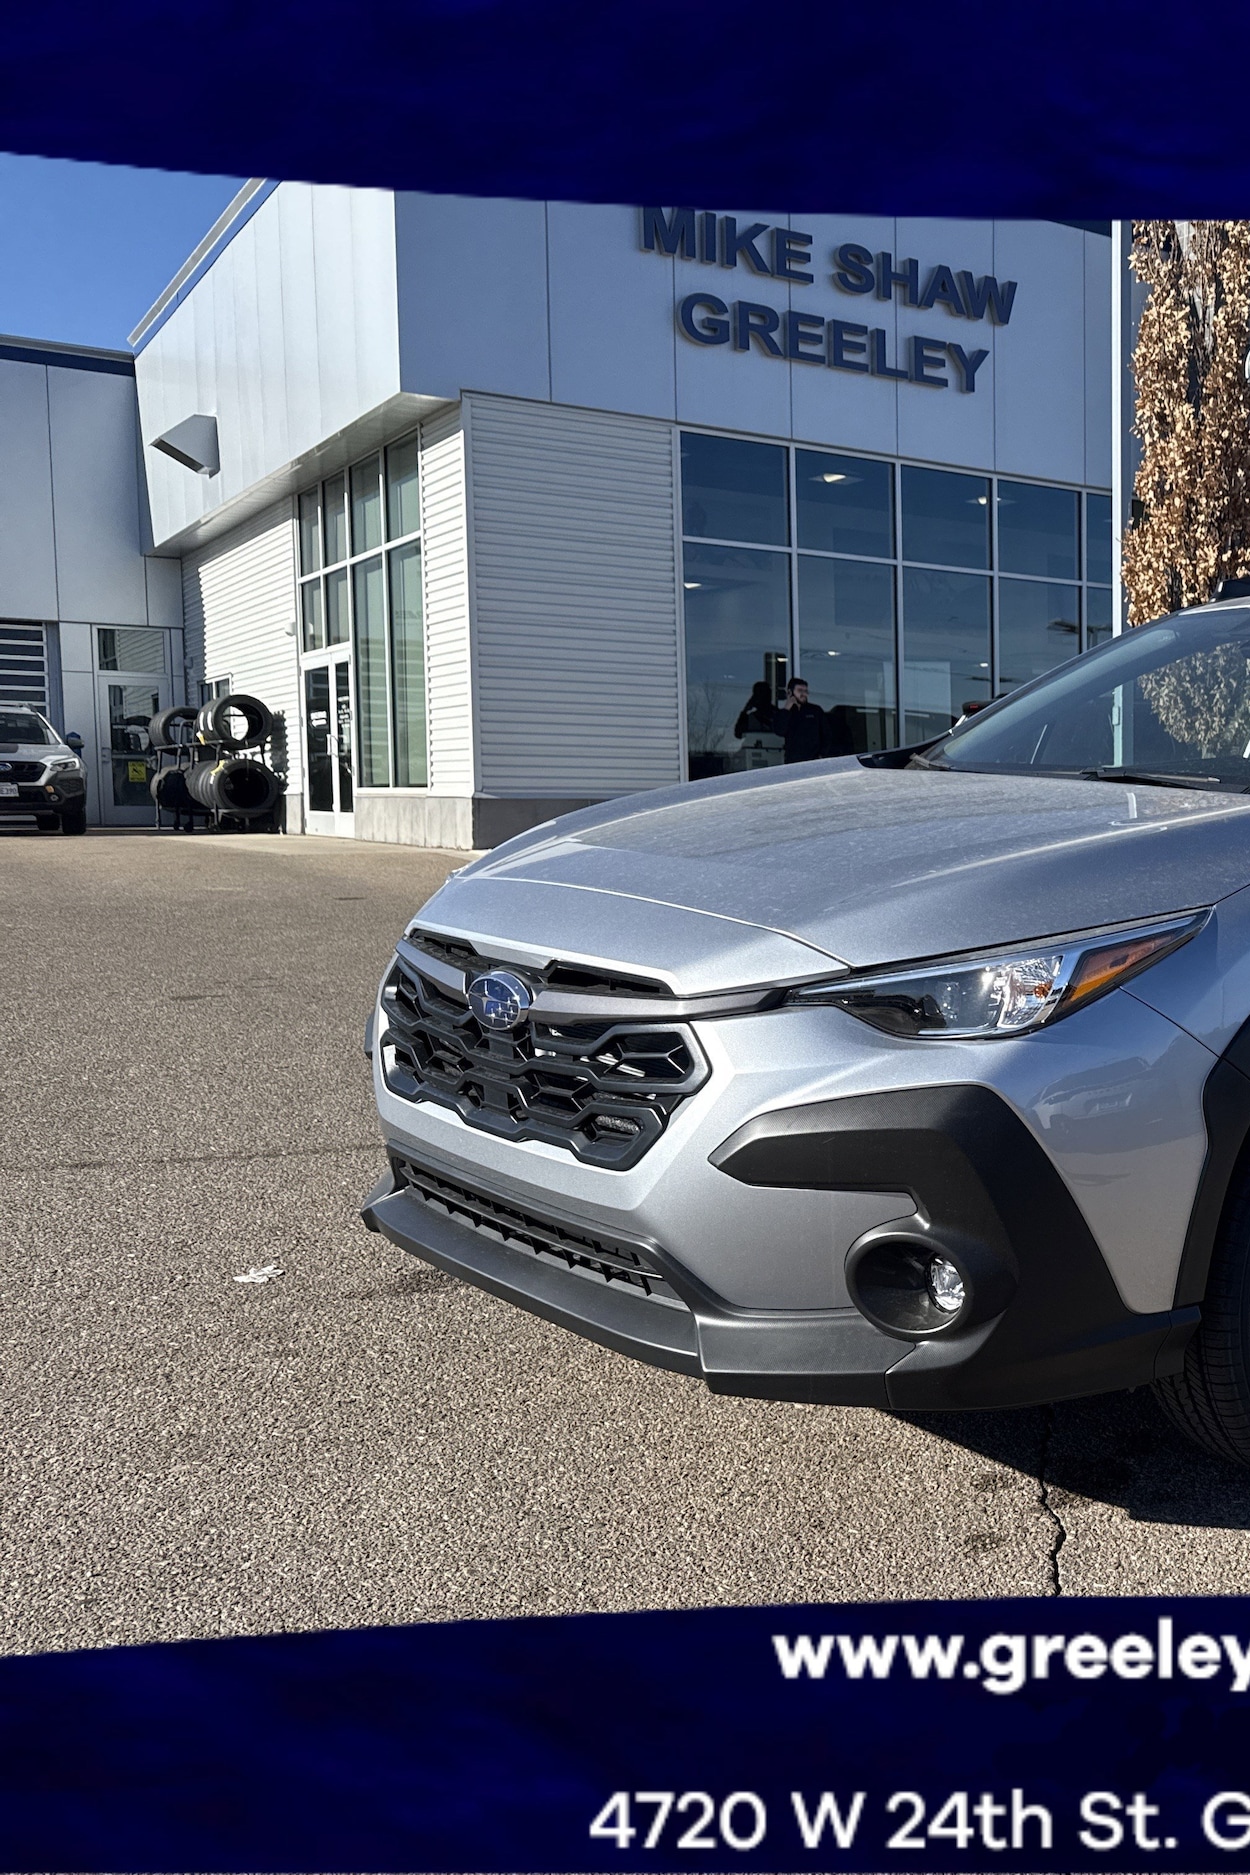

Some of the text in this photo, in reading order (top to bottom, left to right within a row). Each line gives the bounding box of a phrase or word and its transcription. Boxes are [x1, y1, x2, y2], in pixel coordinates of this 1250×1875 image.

[640, 206, 1018, 326] MIKE SHAW
[677, 292, 990, 394] GREELEY
